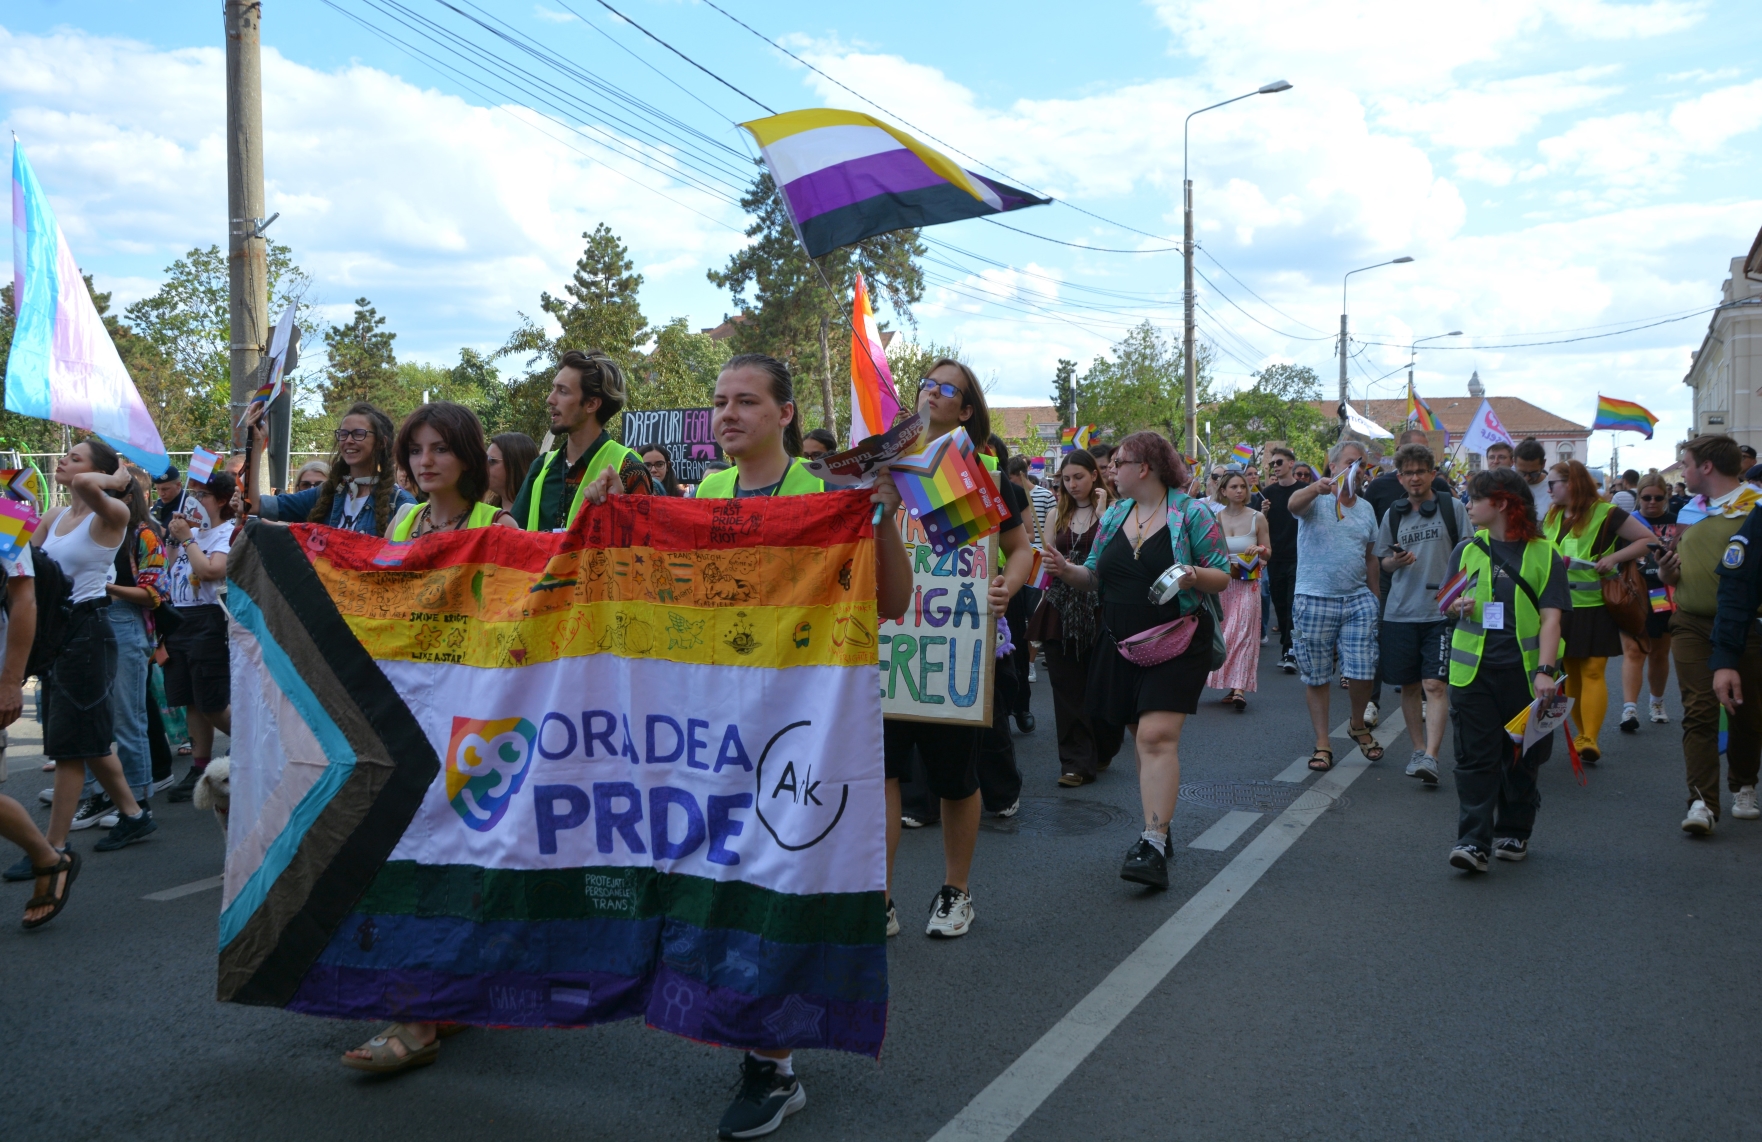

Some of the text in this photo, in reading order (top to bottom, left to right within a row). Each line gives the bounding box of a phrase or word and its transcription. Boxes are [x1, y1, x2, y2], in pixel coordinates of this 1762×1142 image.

[625, 410, 683, 447] DREPTURI
[886, 425, 924, 456] Oradea
[663, 444, 688, 461] SAJE
[827, 452, 873, 470] tuturor
[712, 506, 743, 517] FIRST
[712, 516, 744, 525] PRIDE
[710, 531, 738, 544] RIOT
[1401, 528, 1439, 545] HARLEM
[667, 552, 692, 560] TRANS
[336, 571, 350, 613] ORADEA
[674, 586, 694, 602] RIGHTS
[854, 604, 873, 613] MAKE
[410, 611, 440, 623] SHINE
[412, 652, 433, 660] LIKE
[434, 653, 440, 662] A
[440, 651, 466, 663] STAR!
[536, 709, 754, 773] ORADEA
[533, 781, 754, 866] PRDE
[585, 885, 630, 898] PERSOANELE
[592, 898, 628, 911] TRANS
[833, 1005, 881, 1023] LOVE
